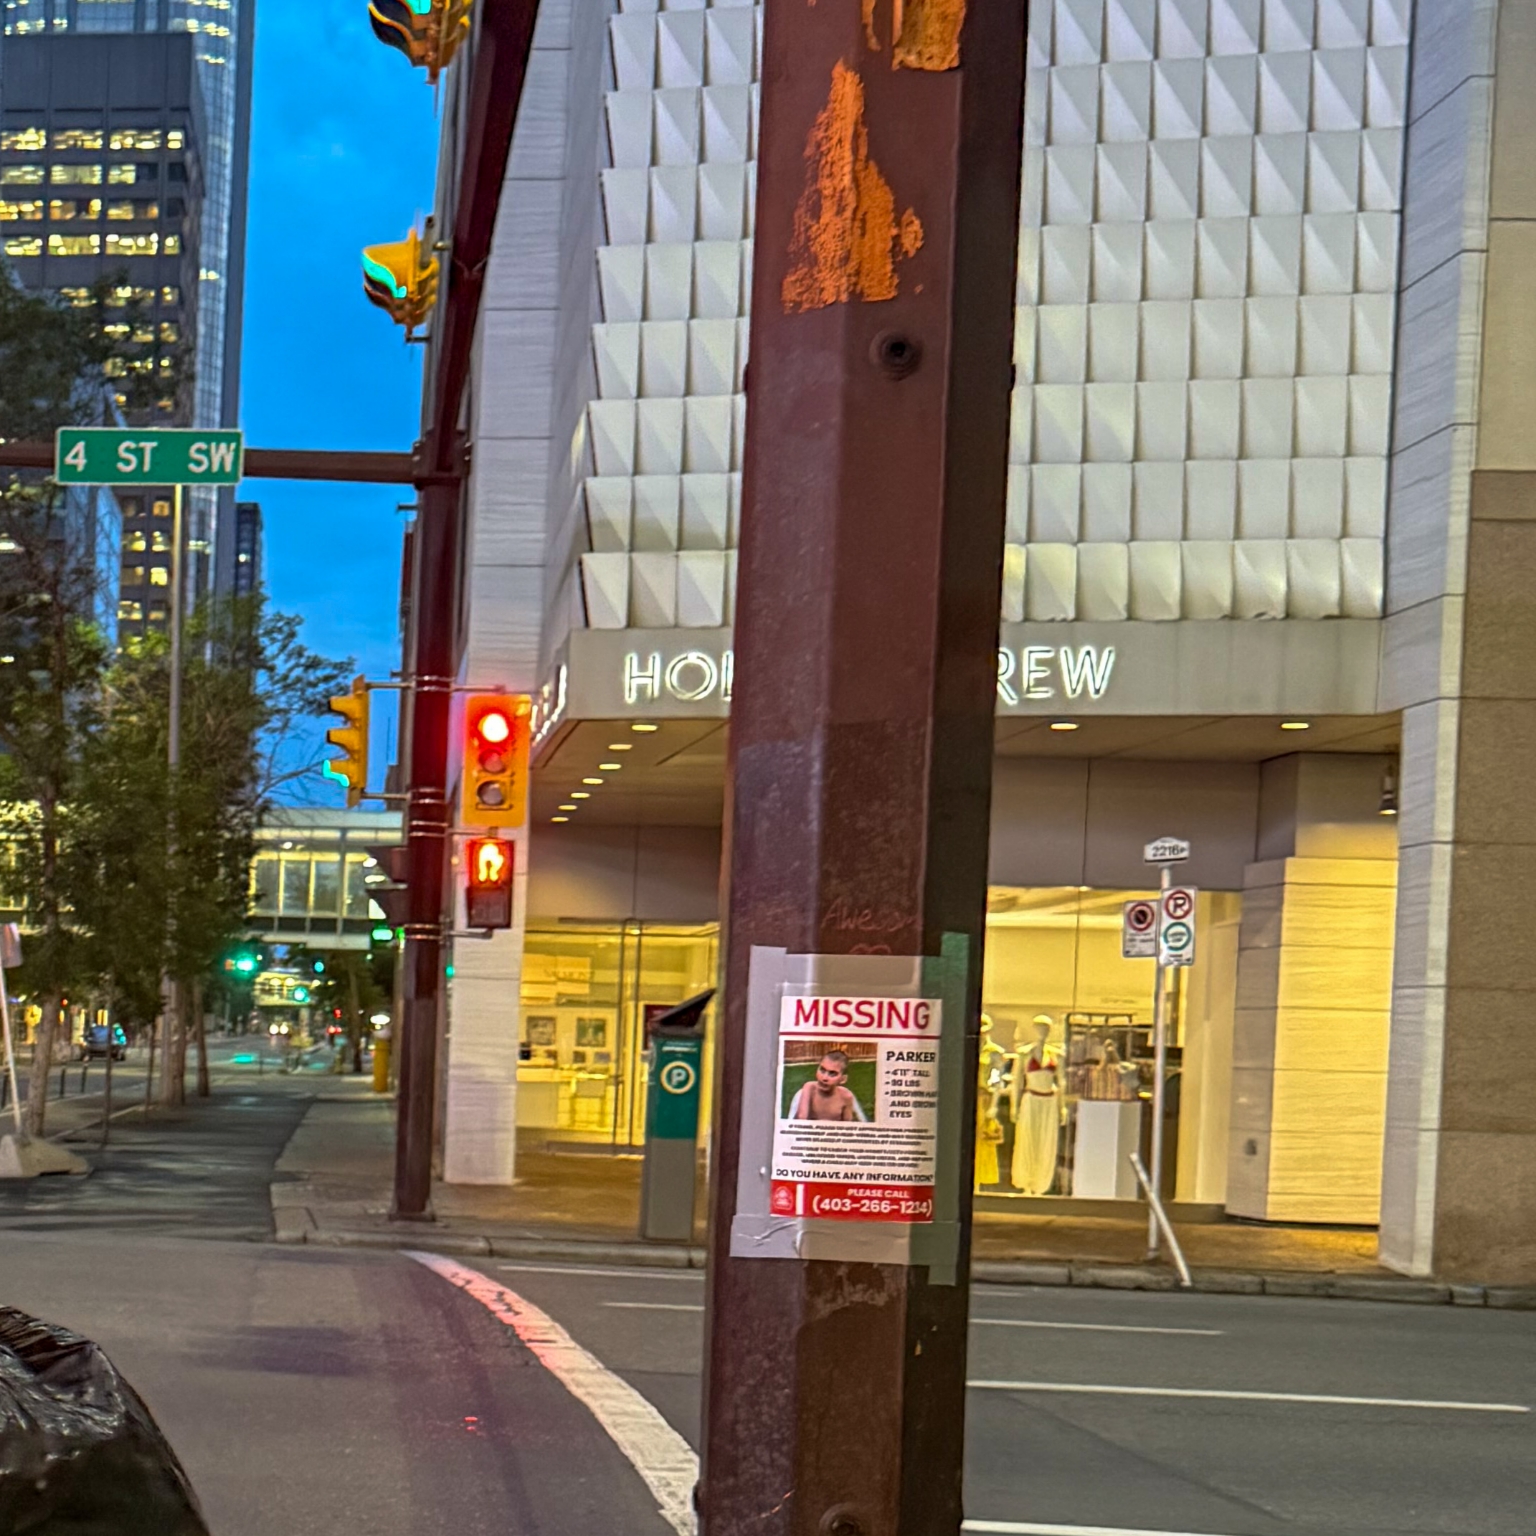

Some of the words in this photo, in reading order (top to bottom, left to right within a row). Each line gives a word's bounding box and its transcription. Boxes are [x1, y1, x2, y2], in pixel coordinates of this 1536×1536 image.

[64, 440, 88, 473] 4
[116, 440, 159, 473] ST
[187, 441, 237, 474] SW
[794, 998, 931, 1030] MISSING
[886, 1050, 936, 1063] PARKER
[904, 1079, 921, 1088] LBS
[889, 1100, 911, 1108] AND
[889, 1110, 912, 1118] EYES
[776, 1168, 789, 1177] DO
[790, 1169, 811, 1178] YOU
[812, 1170, 841, 1180] HAVE
[842, 1171, 865, 1181] ANY
[847, 1188, 883, 1198] PLEASE
[884, 1189, 910, 1199] CALL
